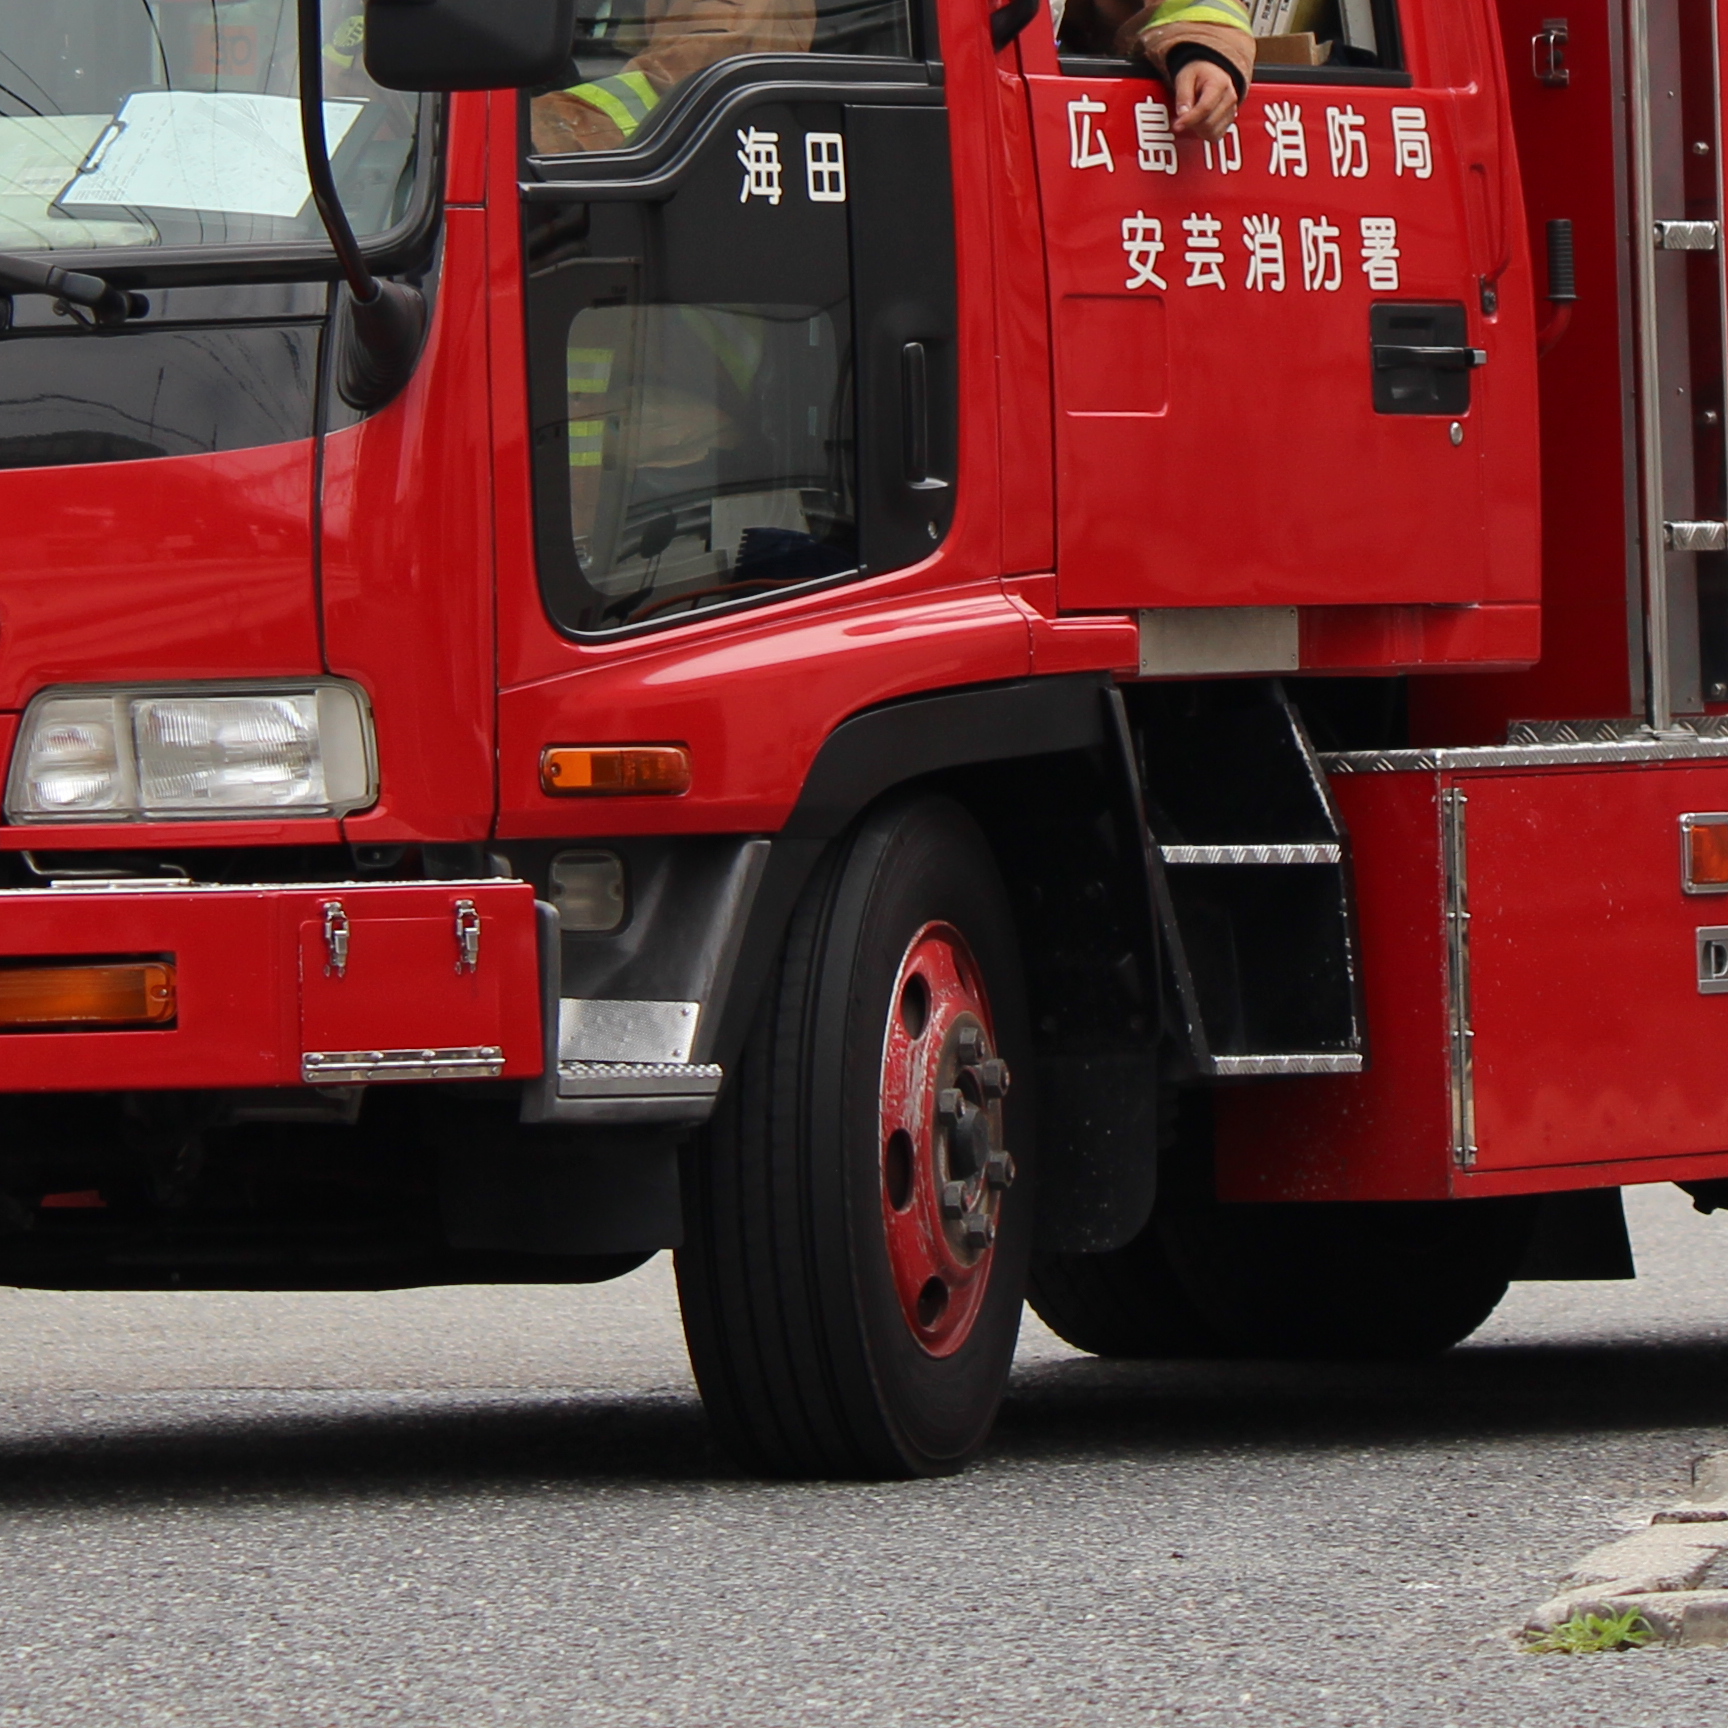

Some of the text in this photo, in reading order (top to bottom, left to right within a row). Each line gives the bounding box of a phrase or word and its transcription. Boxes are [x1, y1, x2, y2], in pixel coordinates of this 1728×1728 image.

[737, 126, 846, 205] 海田
[1121, 210, 1400, 291] 安芸消防署
